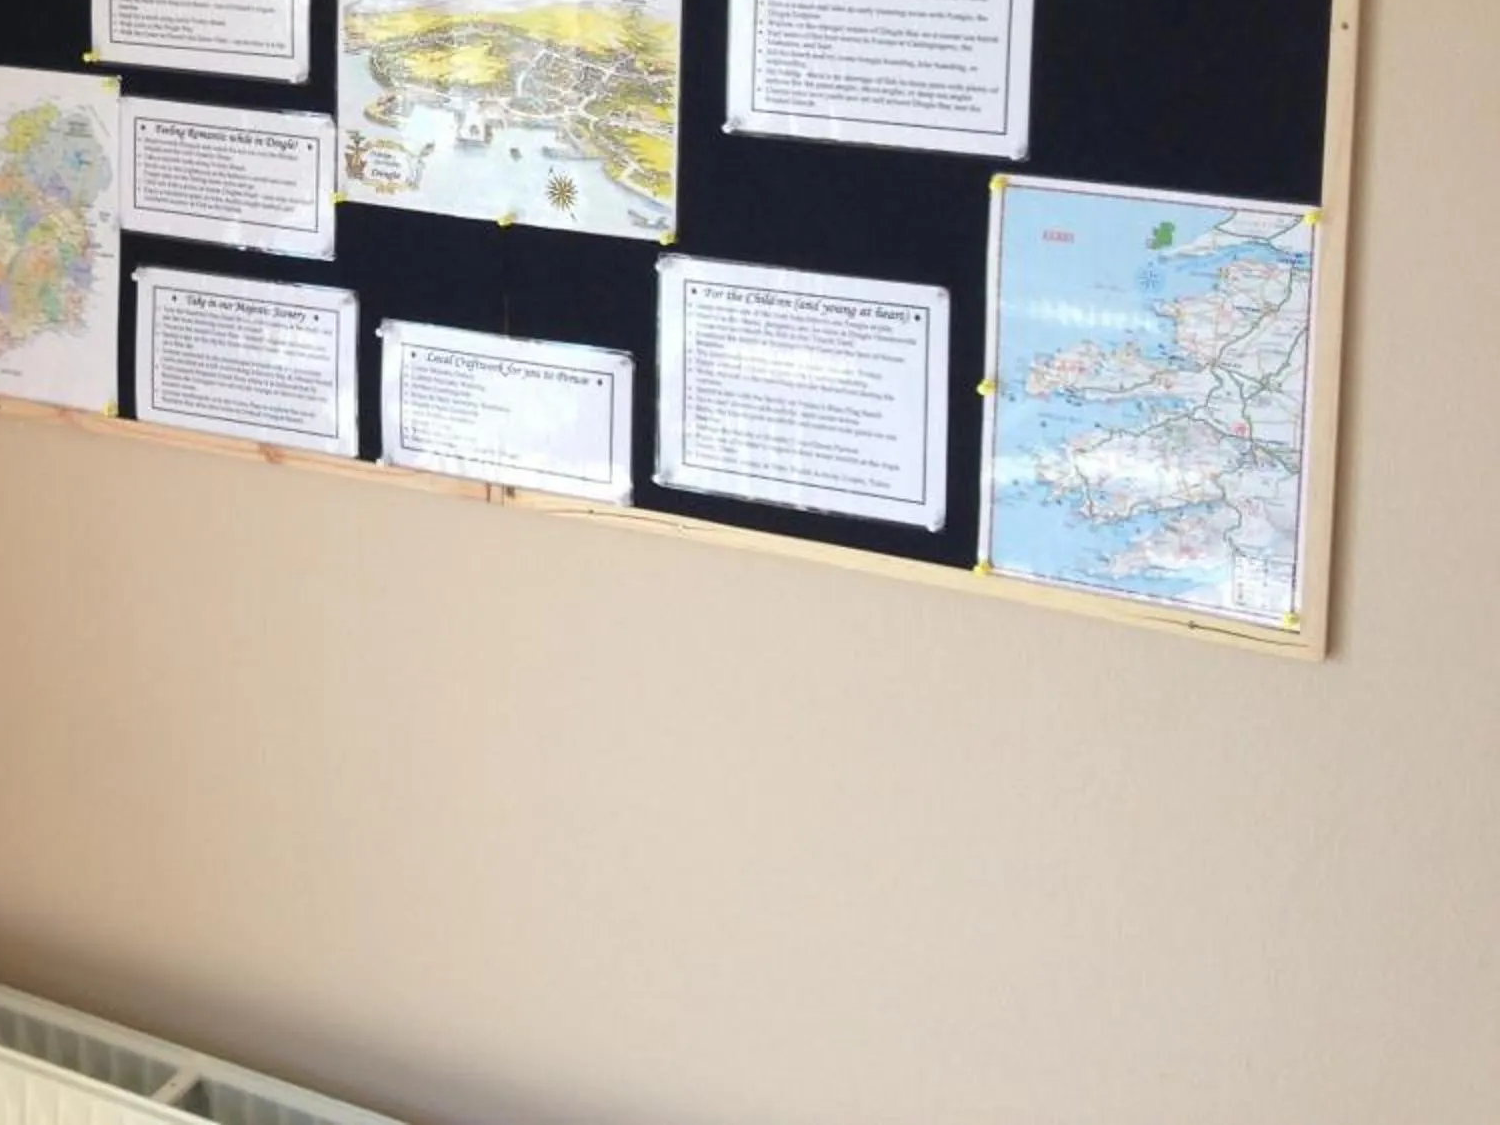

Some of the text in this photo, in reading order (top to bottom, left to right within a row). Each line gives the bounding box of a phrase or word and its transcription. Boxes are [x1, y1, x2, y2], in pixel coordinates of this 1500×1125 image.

[703, 287, 725, 300] For
[726, 288, 743, 302] the
[745, 291, 792, 309] Children
[821, 302, 856, 318] young
[860, 305, 873, 316] at
[426, 351, 454, 365] Local
